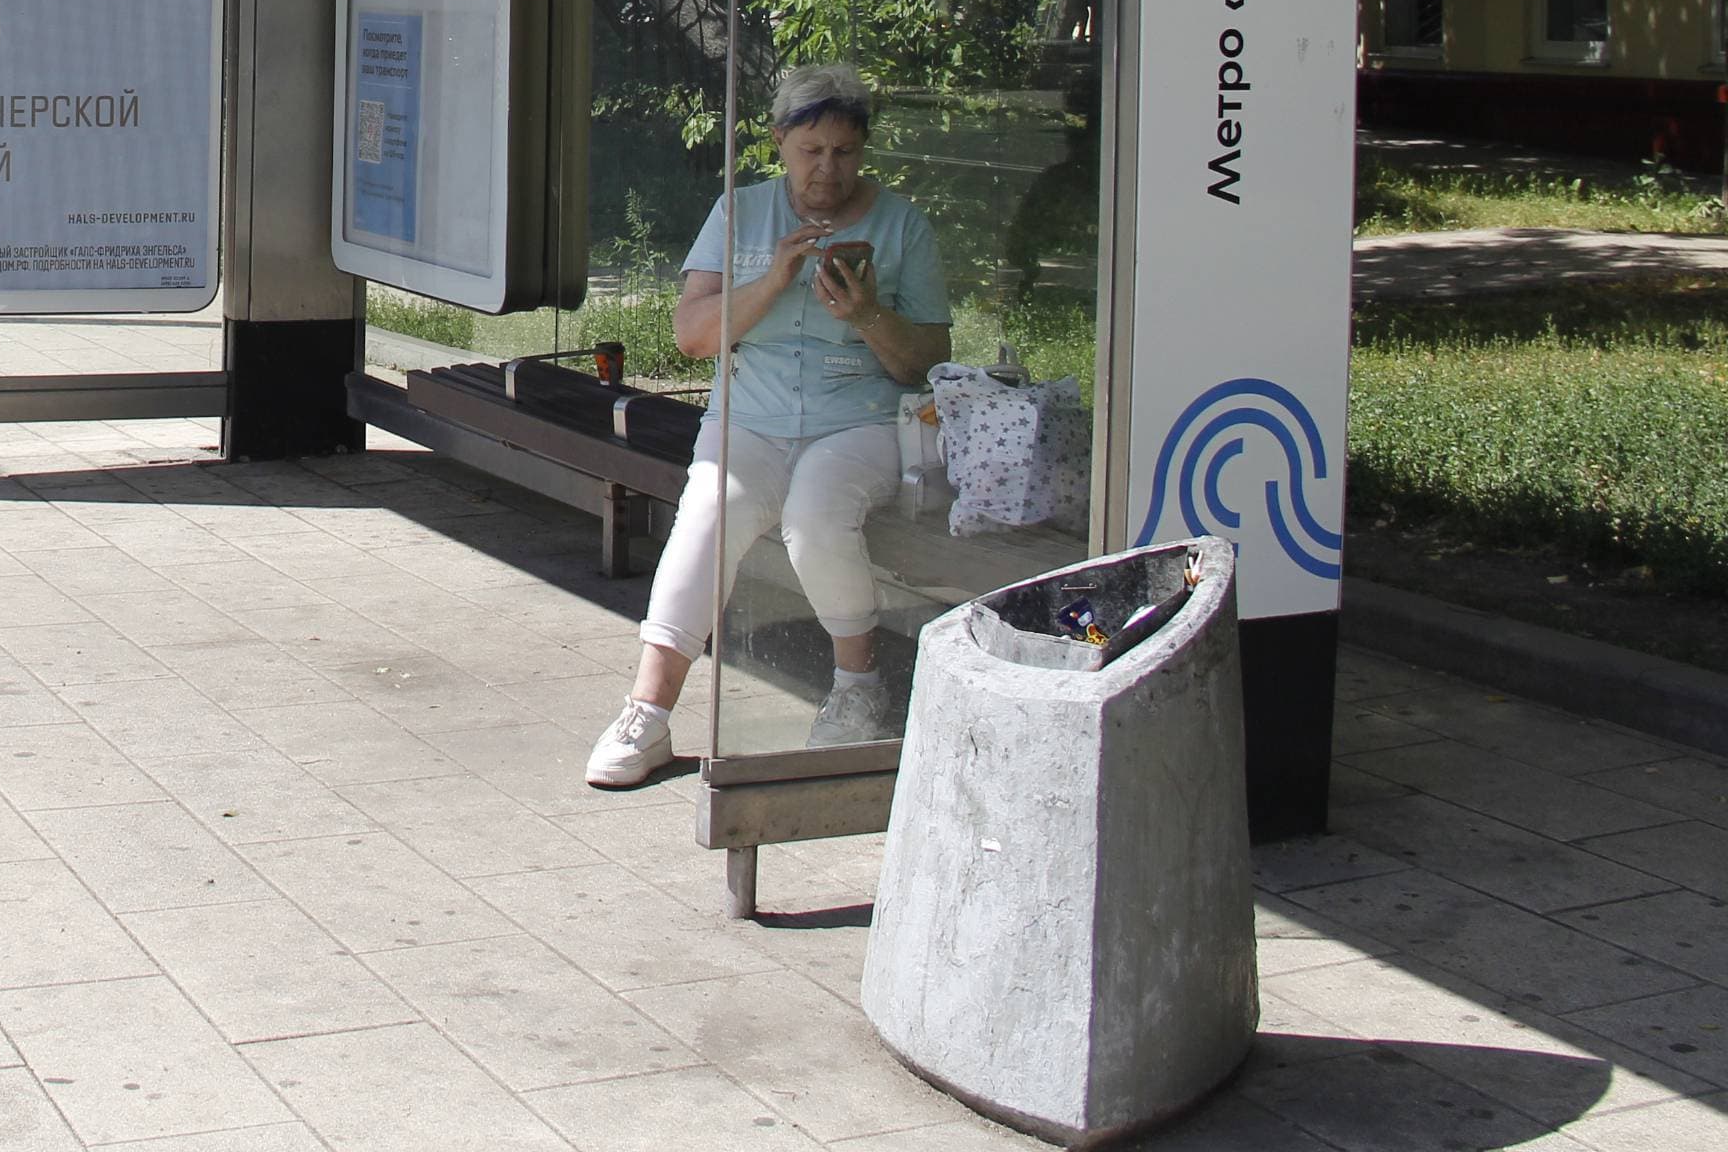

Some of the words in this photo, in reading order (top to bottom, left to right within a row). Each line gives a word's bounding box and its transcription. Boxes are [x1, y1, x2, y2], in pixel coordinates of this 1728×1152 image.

[1206, 28, 1251, 205] Метро
[68, 212, 195, 224] HALS-DEVELOPMENT.RU
[13, 245, 68, 259] ЗАСТРОЙЩИК
[70, 245, 141, 258] «ГАЛС-ФРИДРИХА
[142, 244, 187, 257] ЭНГЕЛЬСА»
[33, 257, 91, 272] ПОДРОБНОСТИ
[93, 257, 105, 269] НА
[106, 256, 195, 269] HALS-DEVELOPMENT.RU
